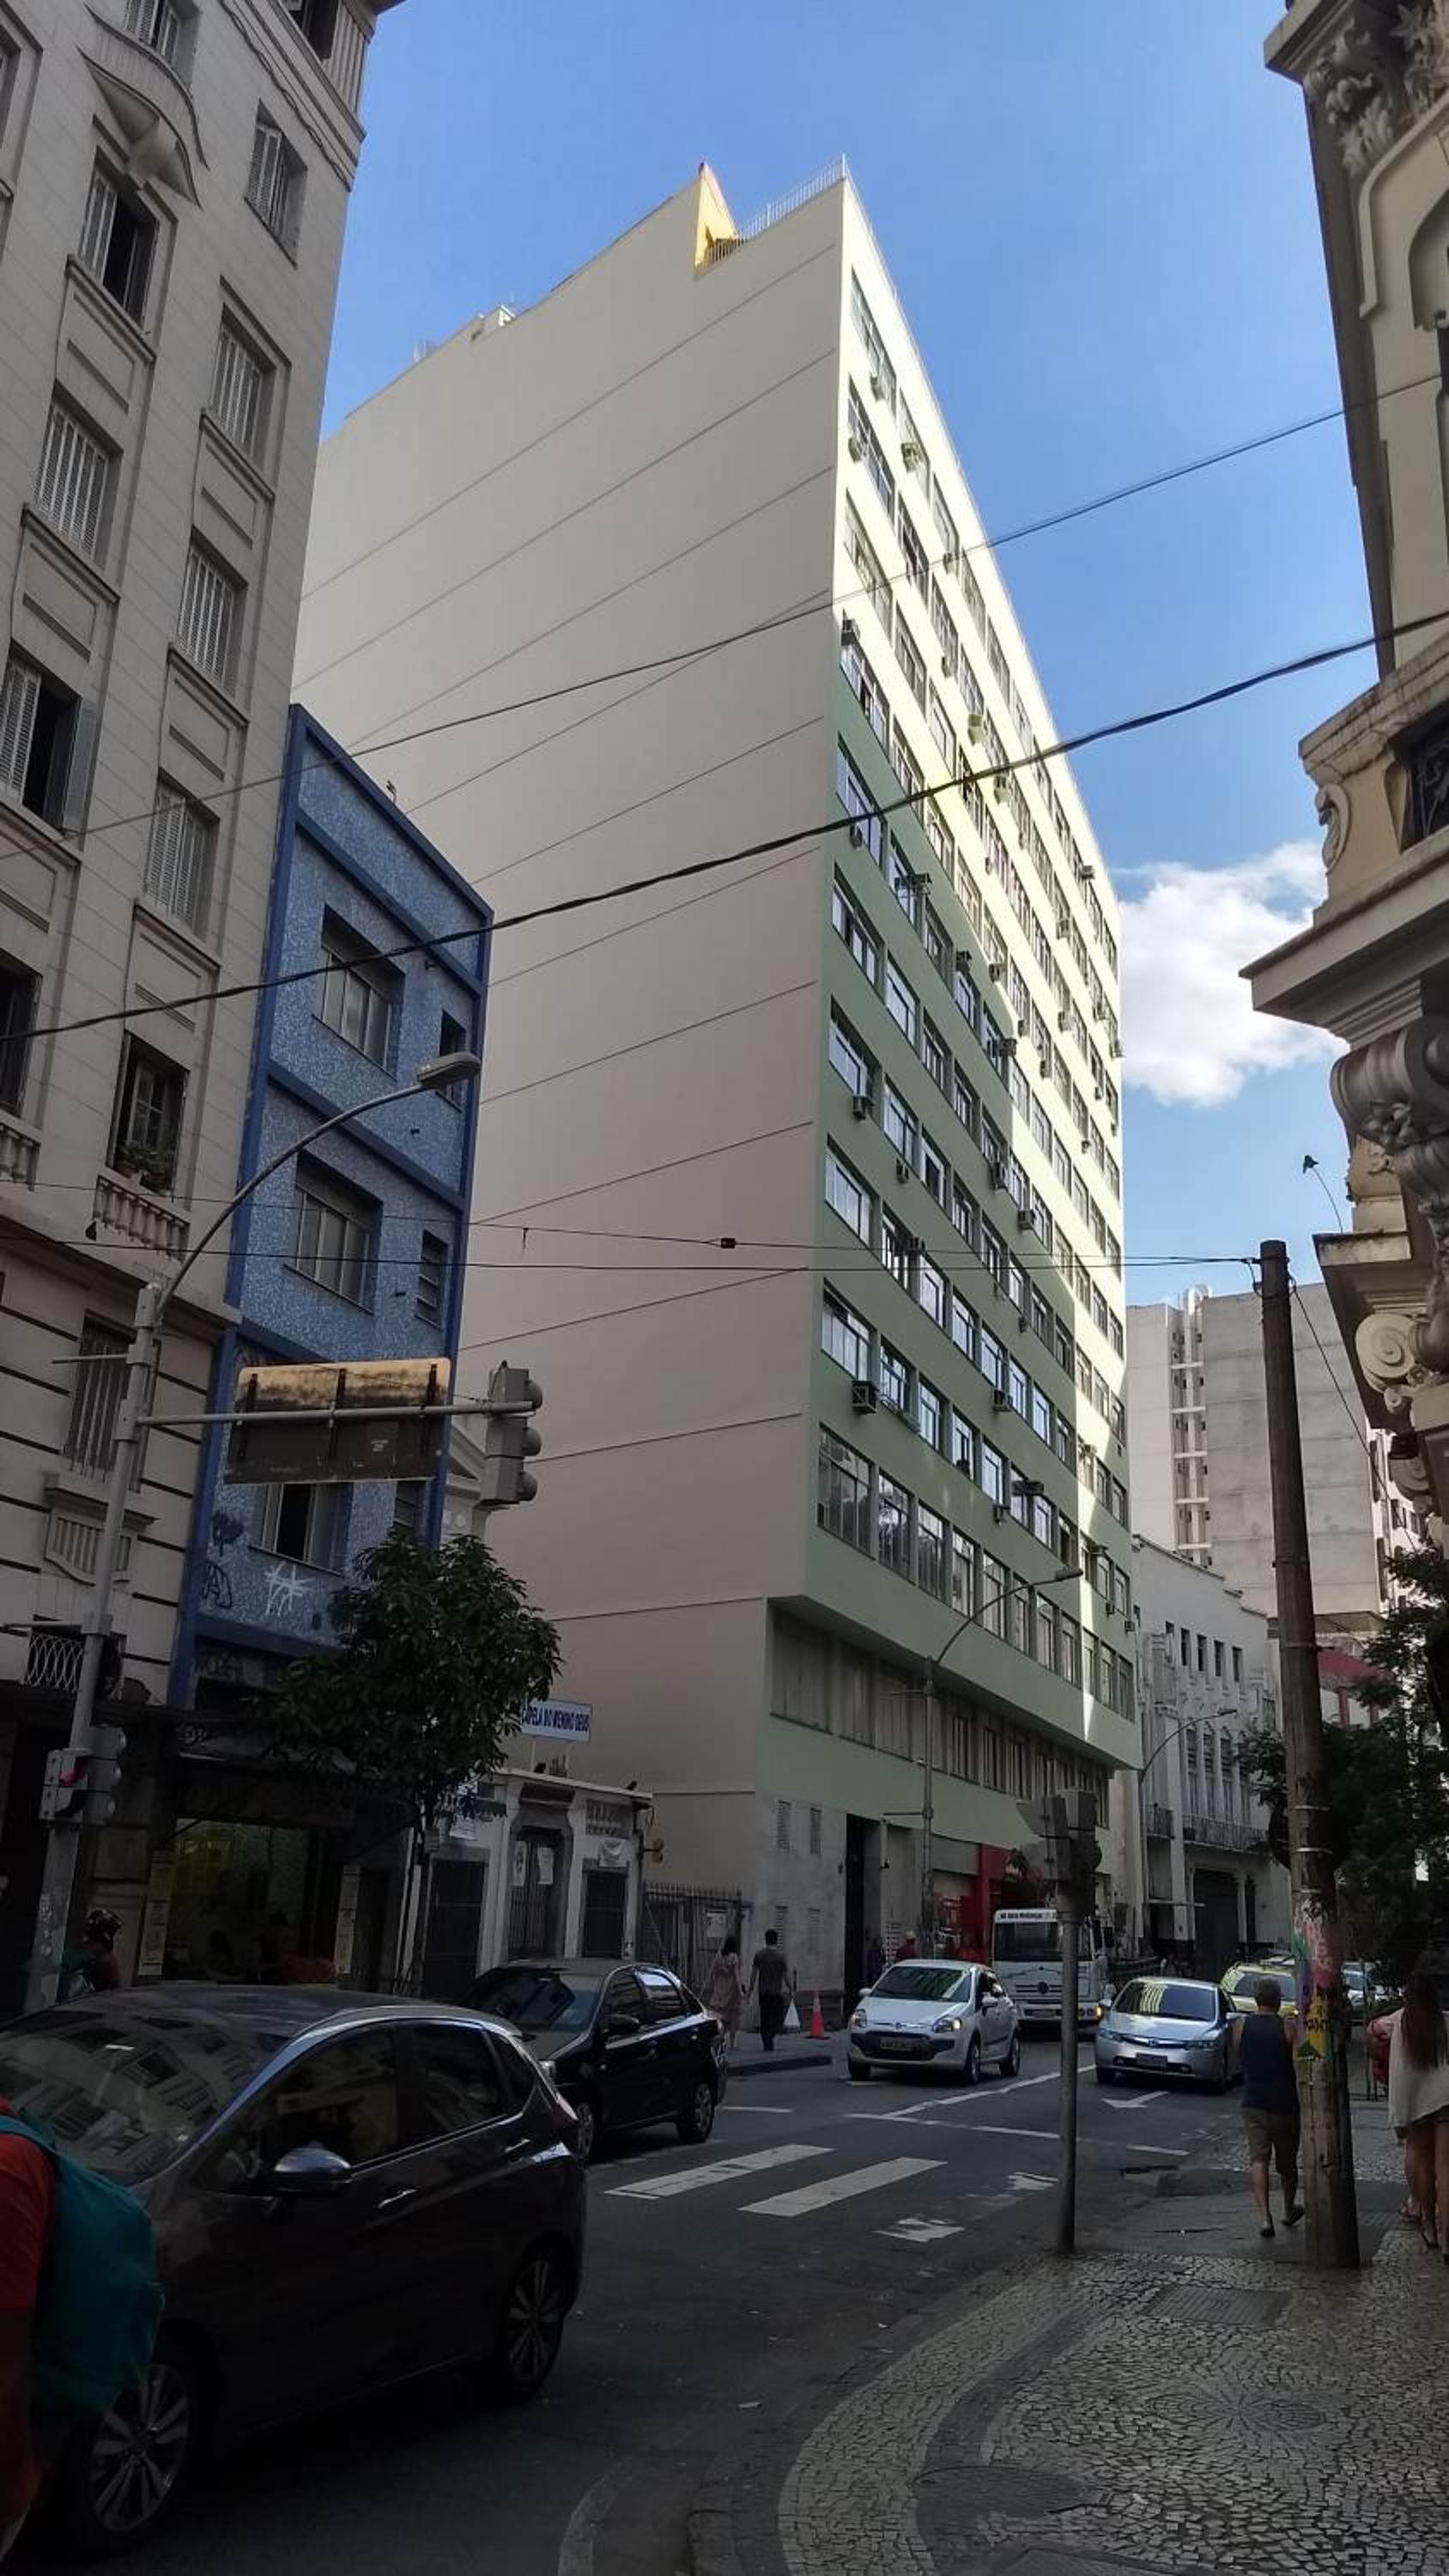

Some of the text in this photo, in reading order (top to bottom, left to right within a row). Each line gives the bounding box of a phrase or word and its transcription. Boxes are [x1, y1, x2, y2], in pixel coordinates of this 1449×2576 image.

[543, 1709, 552, 1727] DO
[553, 1710, 573, 1730] MENINO
[574, 1713, 590, 1732] DEUS
